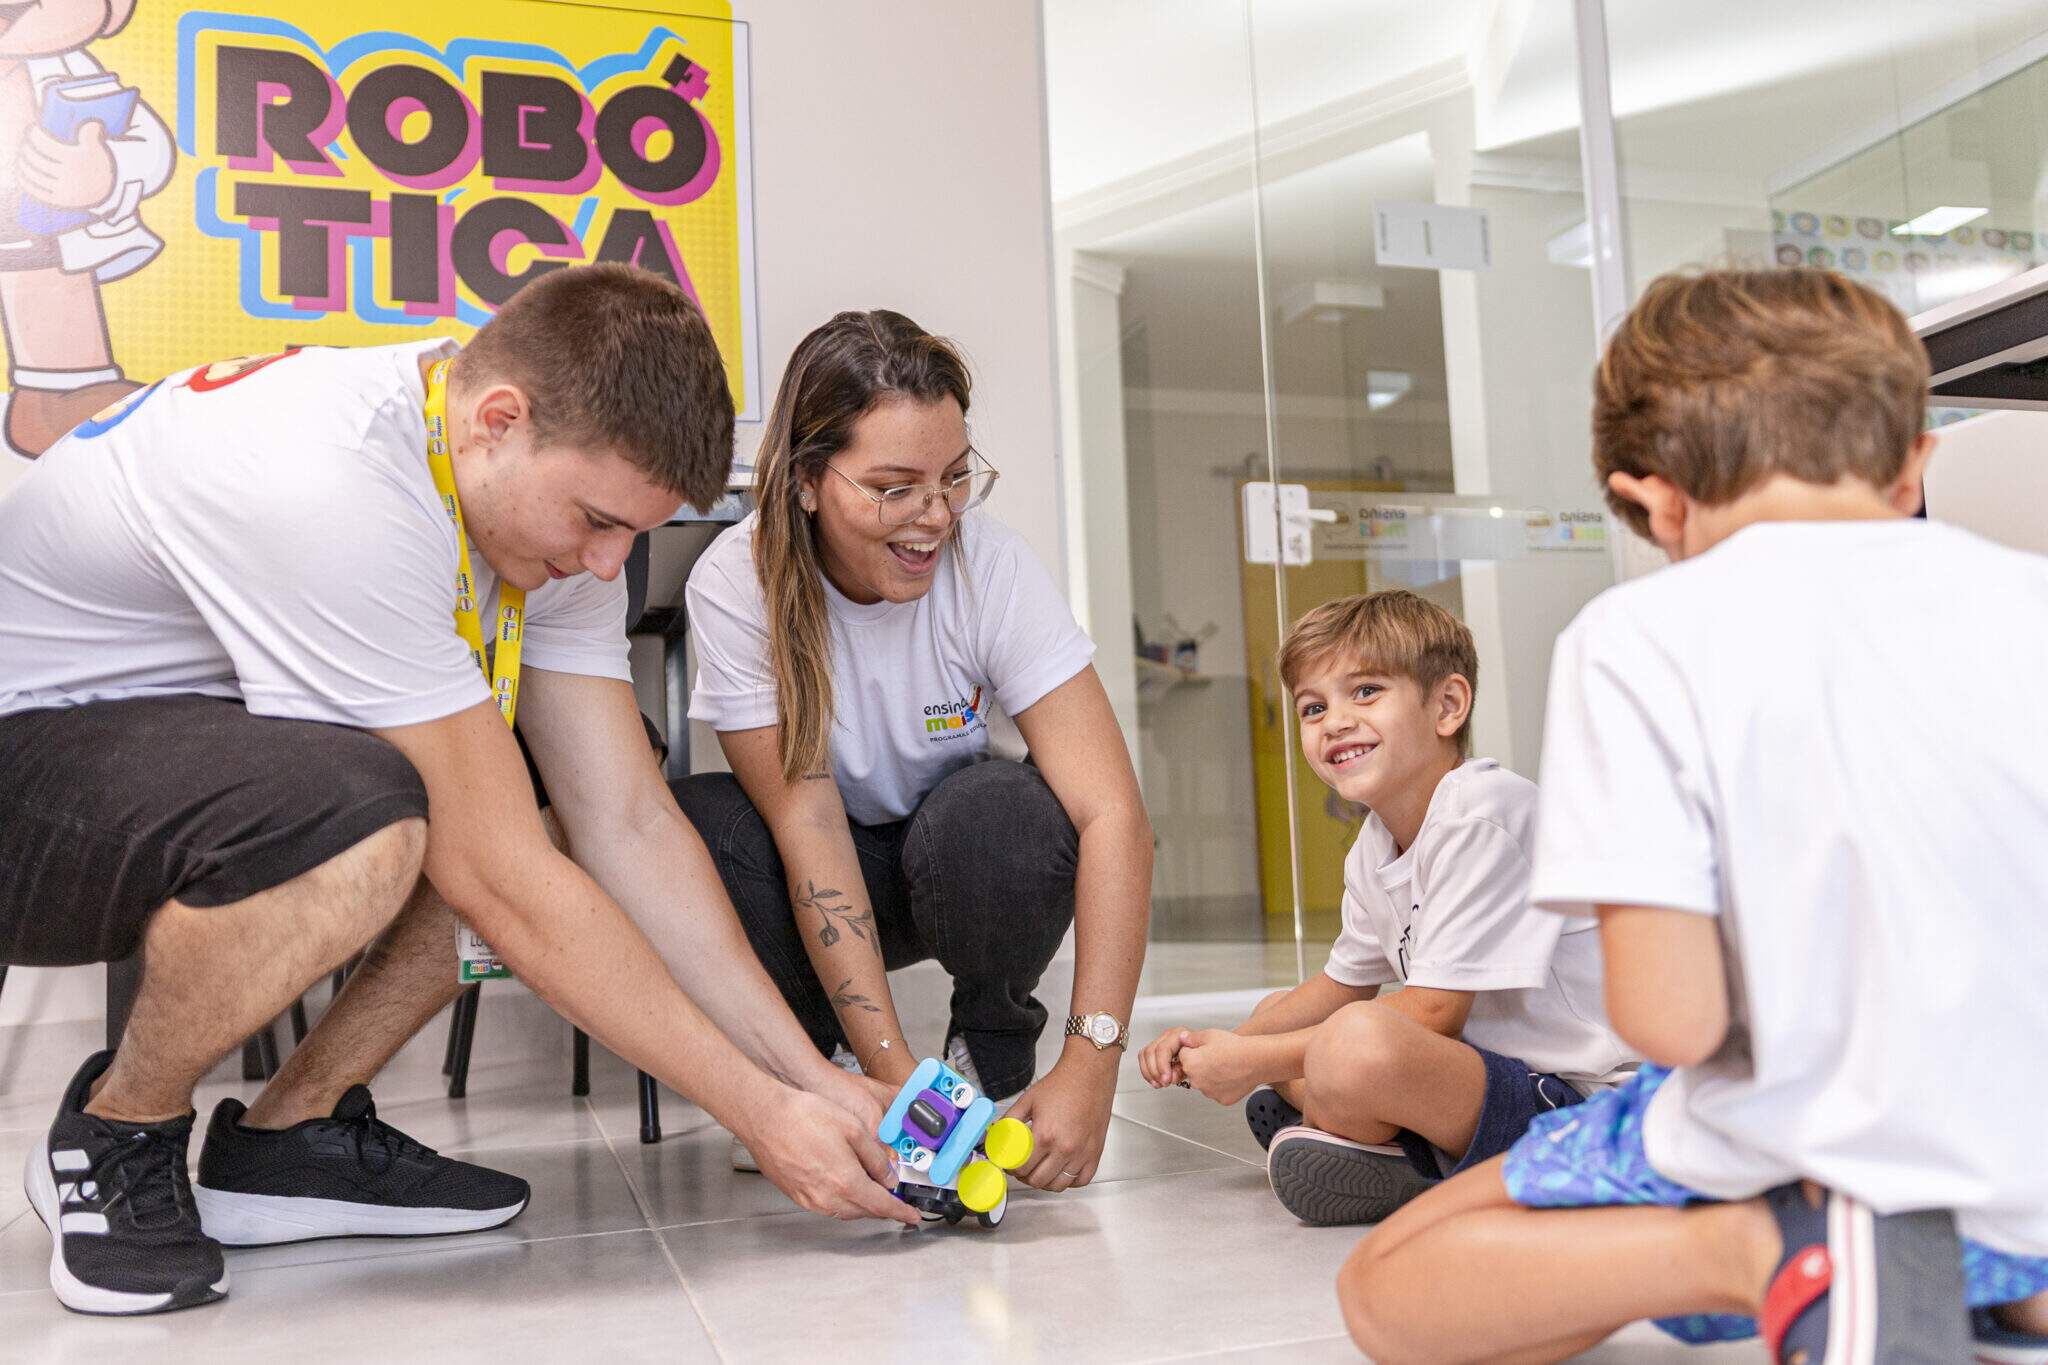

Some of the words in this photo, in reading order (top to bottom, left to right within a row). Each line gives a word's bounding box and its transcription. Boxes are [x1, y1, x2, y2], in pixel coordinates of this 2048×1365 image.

[216, 45, 720, 206] ROBÓ
[924, 698, 968, 715] ensino
[926, 706, 974, 732] mais
[930, 731, 970, 742] PROGRAMAS
